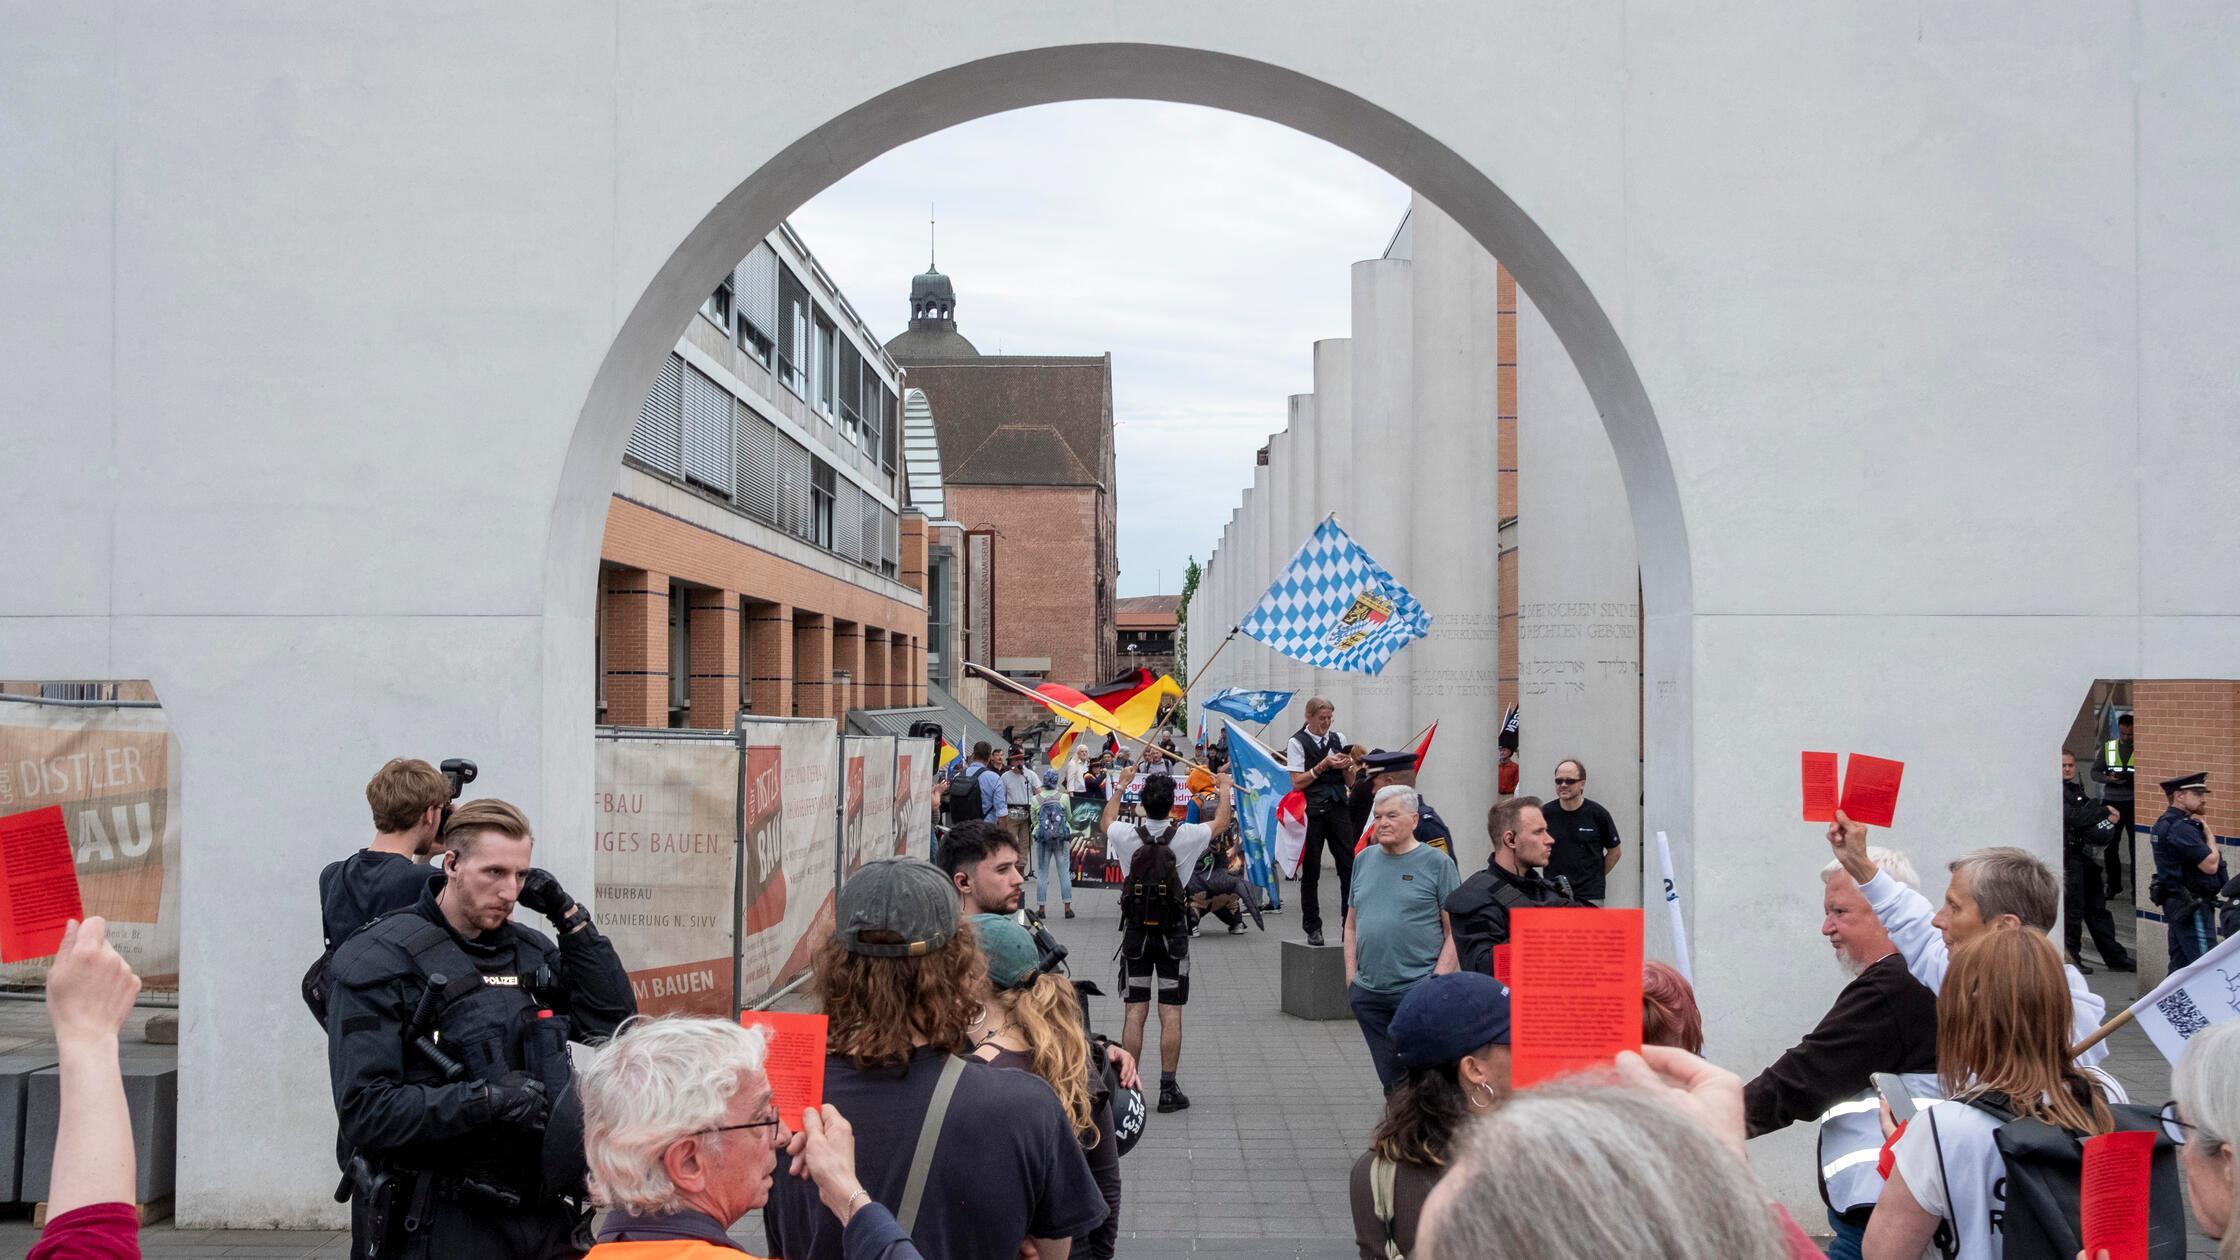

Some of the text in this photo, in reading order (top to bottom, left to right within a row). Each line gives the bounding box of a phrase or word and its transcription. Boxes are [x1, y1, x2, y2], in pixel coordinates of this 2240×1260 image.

[981, 537, 989, 666] ERMANISCHES NATIONALMUSEUM
[1528, 602, 1597, 618] MENSCHEN
[20, 746, 146, 797] DISTLER
[74, 802, 153, 864] AU
[594, 831, 719, 854] IGES BAUEN
[757, 809, 782, 884] BAU
[595, 887, 653, 900] NIEURBAU
[596, 913, 717, 928] NSANIERUNG N. SIVV
[482, 975, 518, 986] POLIZEI
[651, 969, 715, 998] BAUEN
